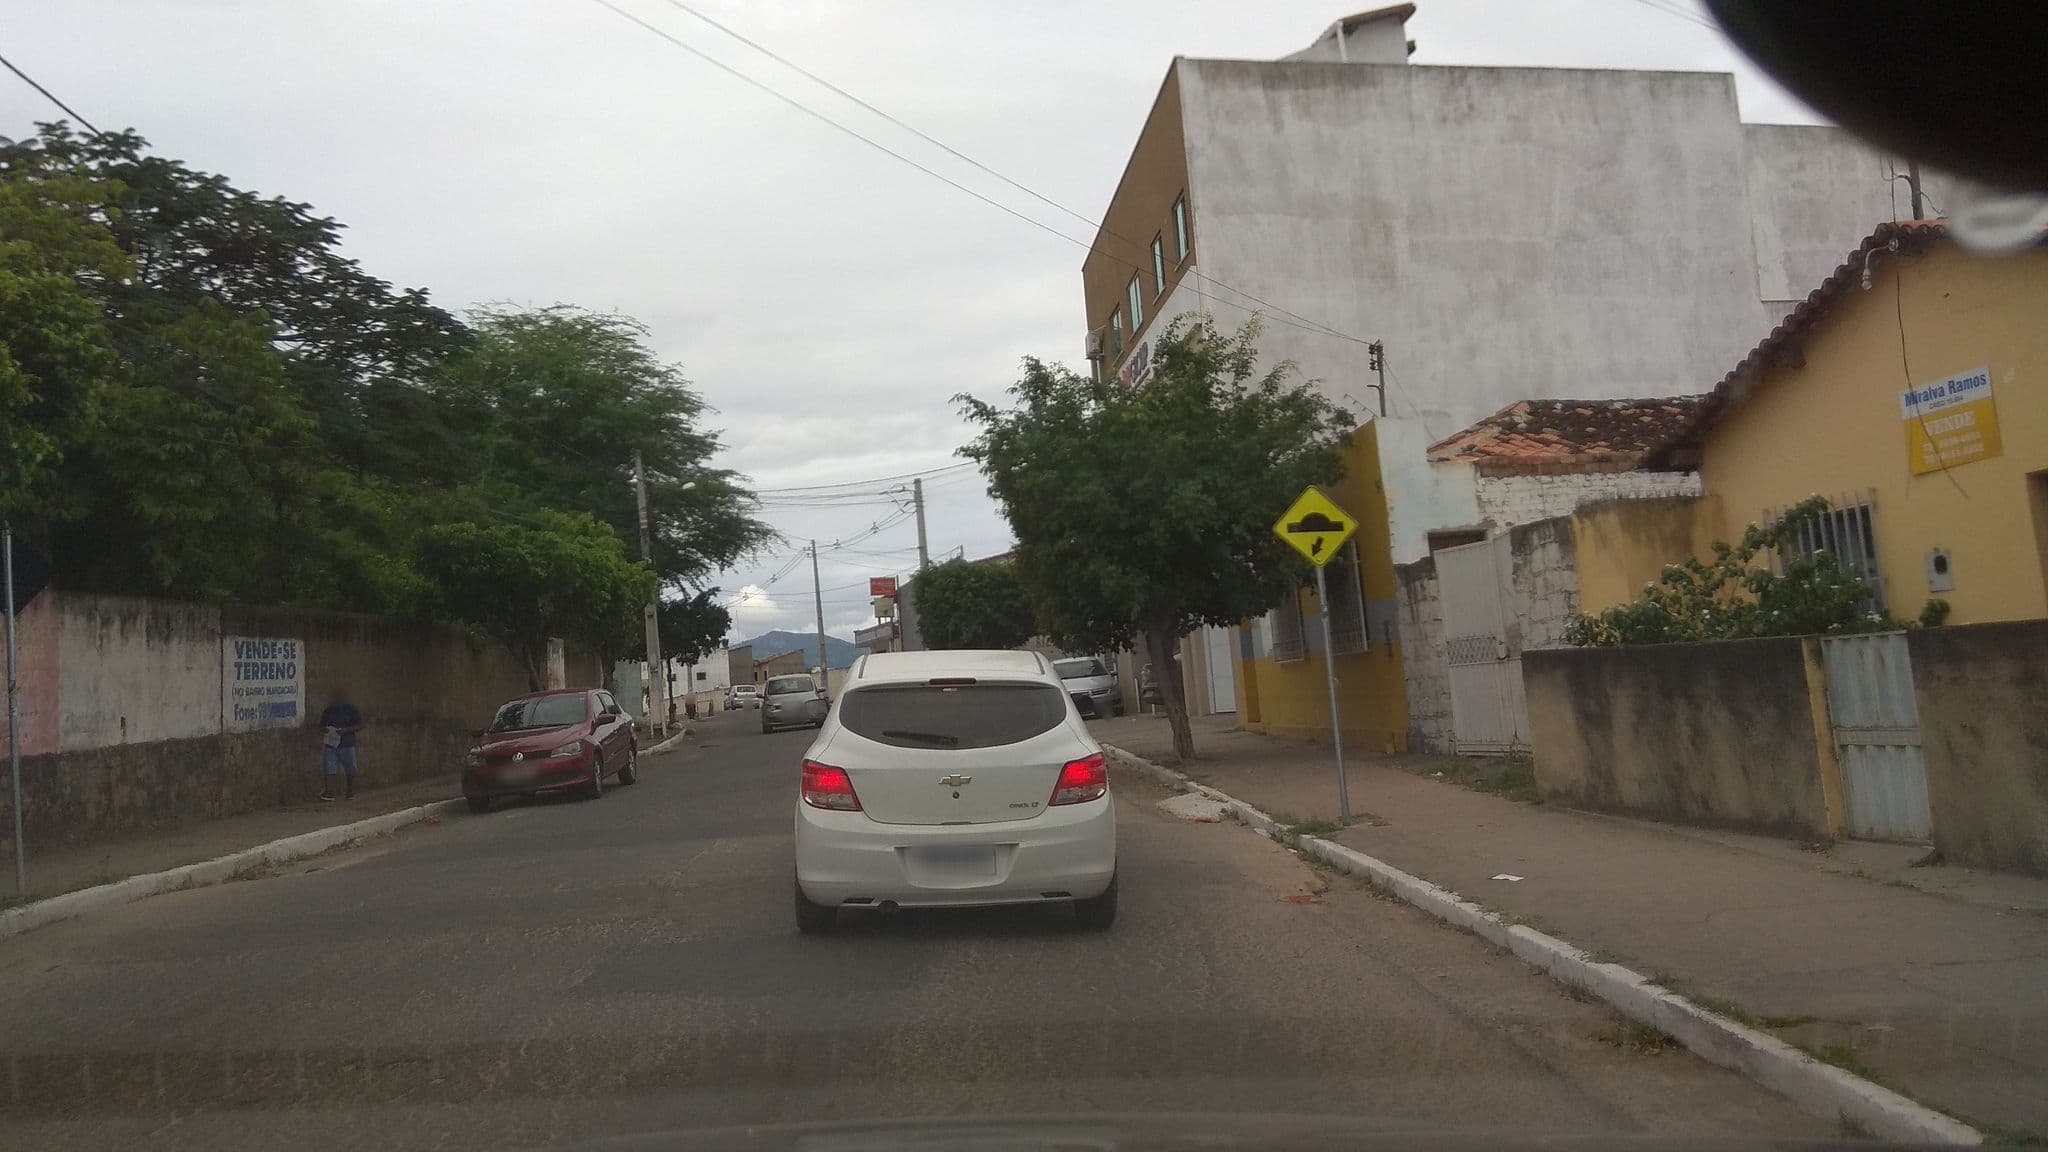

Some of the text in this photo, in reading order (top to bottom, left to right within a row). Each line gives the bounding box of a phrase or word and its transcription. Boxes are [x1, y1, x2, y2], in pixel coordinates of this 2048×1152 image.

[1948, 373, 1987, 395] Ramos
[234, 640, 296, 659] VENDE-SE
[234, 661, 296, 680] TERRENO
